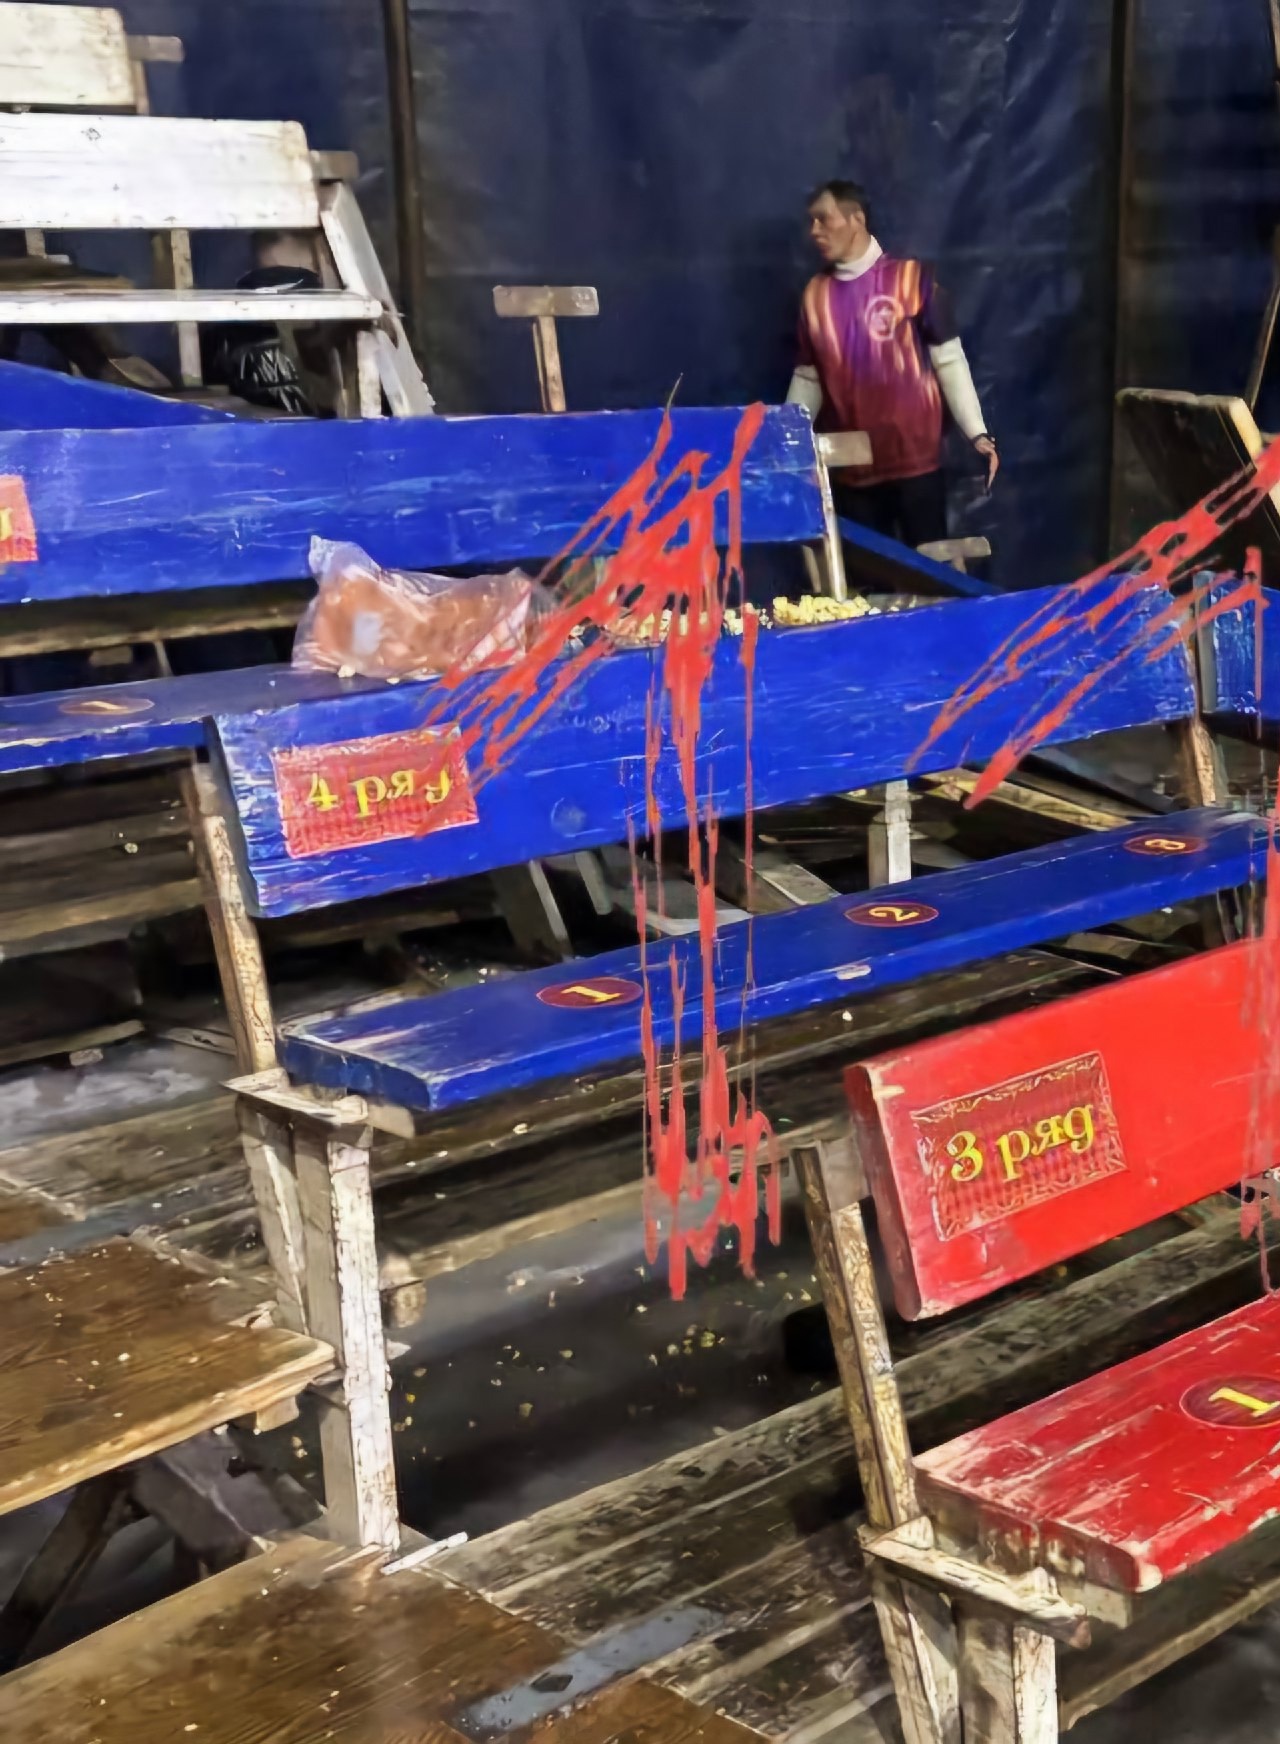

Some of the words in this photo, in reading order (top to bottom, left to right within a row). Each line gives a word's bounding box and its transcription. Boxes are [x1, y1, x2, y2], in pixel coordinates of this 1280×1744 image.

[81, 700, 129, 711] 1
[306, 772, 340, 812] 4
[868, 906, 920, 922] 2
[561, 986, 624, 1004] 1
[946, 1129, 985, 1181] 3
[996, 1103, 1096, 1182] ряд
[1208, 1386, 1280, 1417] 1
